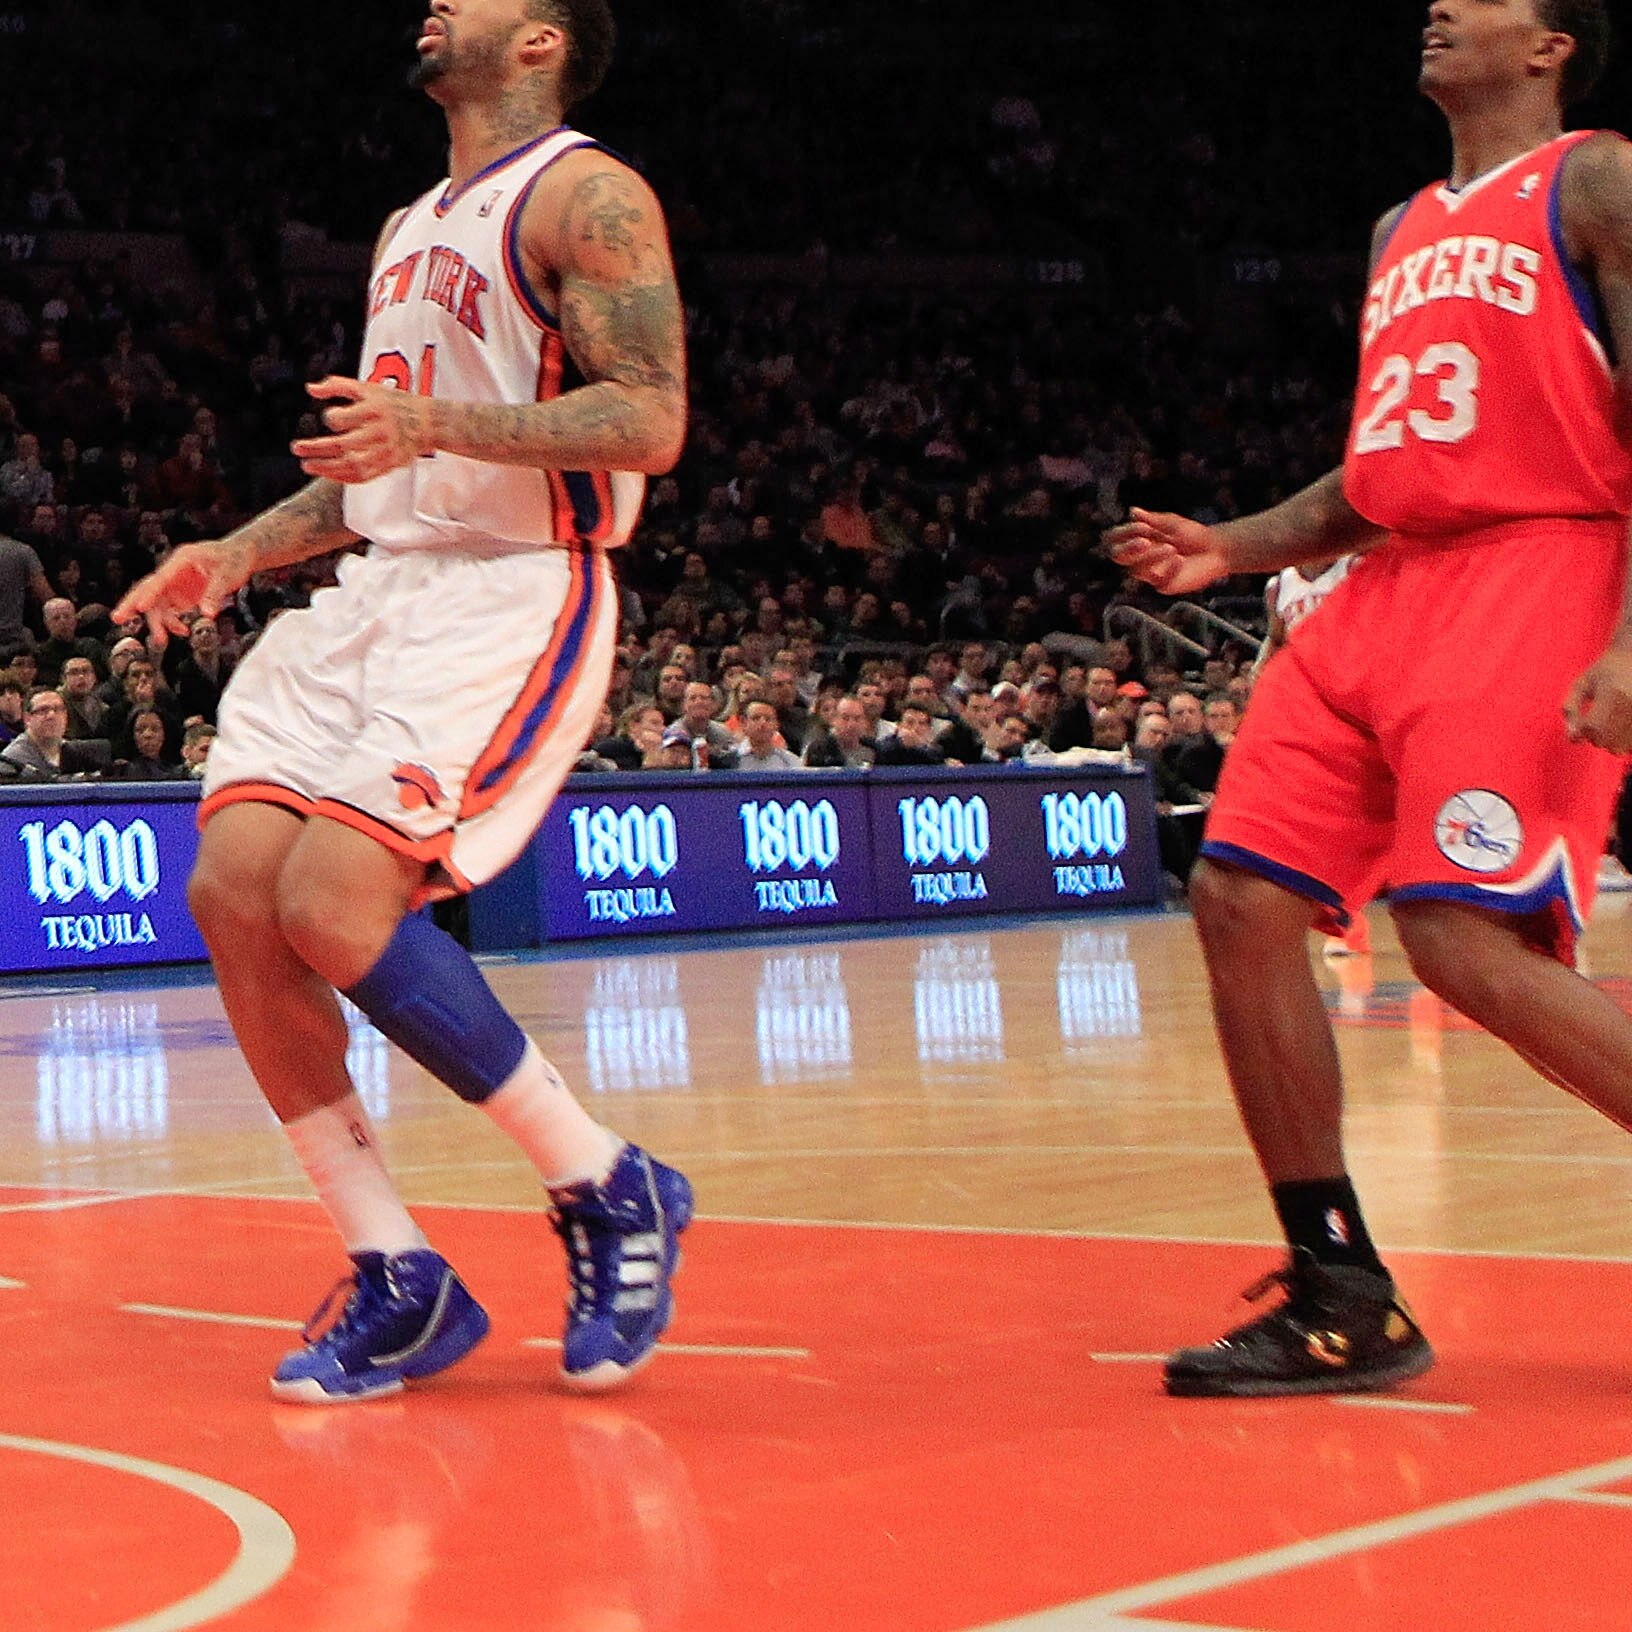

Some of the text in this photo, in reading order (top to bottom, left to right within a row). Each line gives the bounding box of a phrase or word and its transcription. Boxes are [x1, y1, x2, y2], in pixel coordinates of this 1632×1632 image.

[1362, 235, 1542, 349] SIXERS
[1355, 340, 1481, 455] 23
[568, 803, 679, 881] 1800
[739, 798, 841, 874] 1800
[898, 794, 991, 867] 1800
[1040, 790, 1128, 859] 1800
[19, 818, 160, 906] 1800
[754, 878, 839, 914] TEQUILA
[41, 912, 157, 953] TEQUILA
[584, 887, 677, 924] TEQUILA
